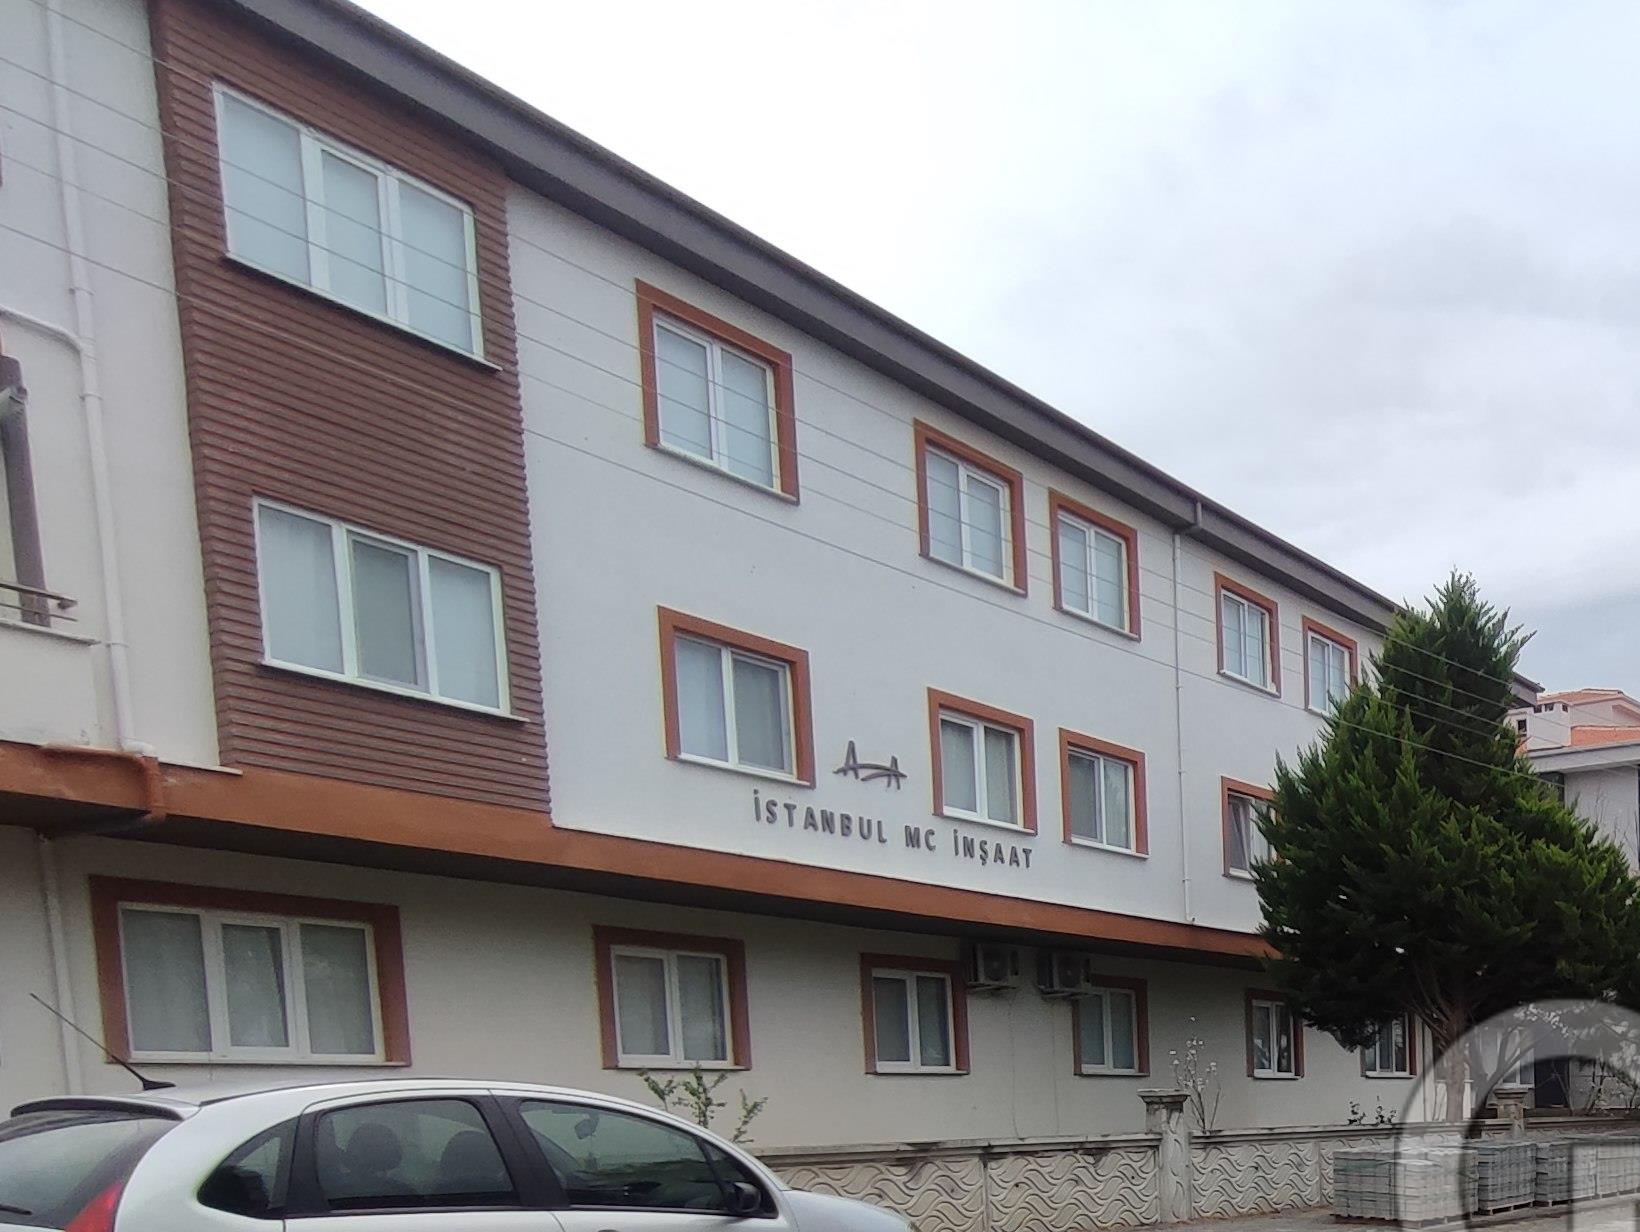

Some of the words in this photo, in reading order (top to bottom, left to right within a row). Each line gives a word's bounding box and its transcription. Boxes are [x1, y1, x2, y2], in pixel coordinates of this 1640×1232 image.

[752, 788, 888, 844] İSTANBUL
[904, 825, 936, 851] MC
[952, 828, 1033, 869] İNŞAAT
